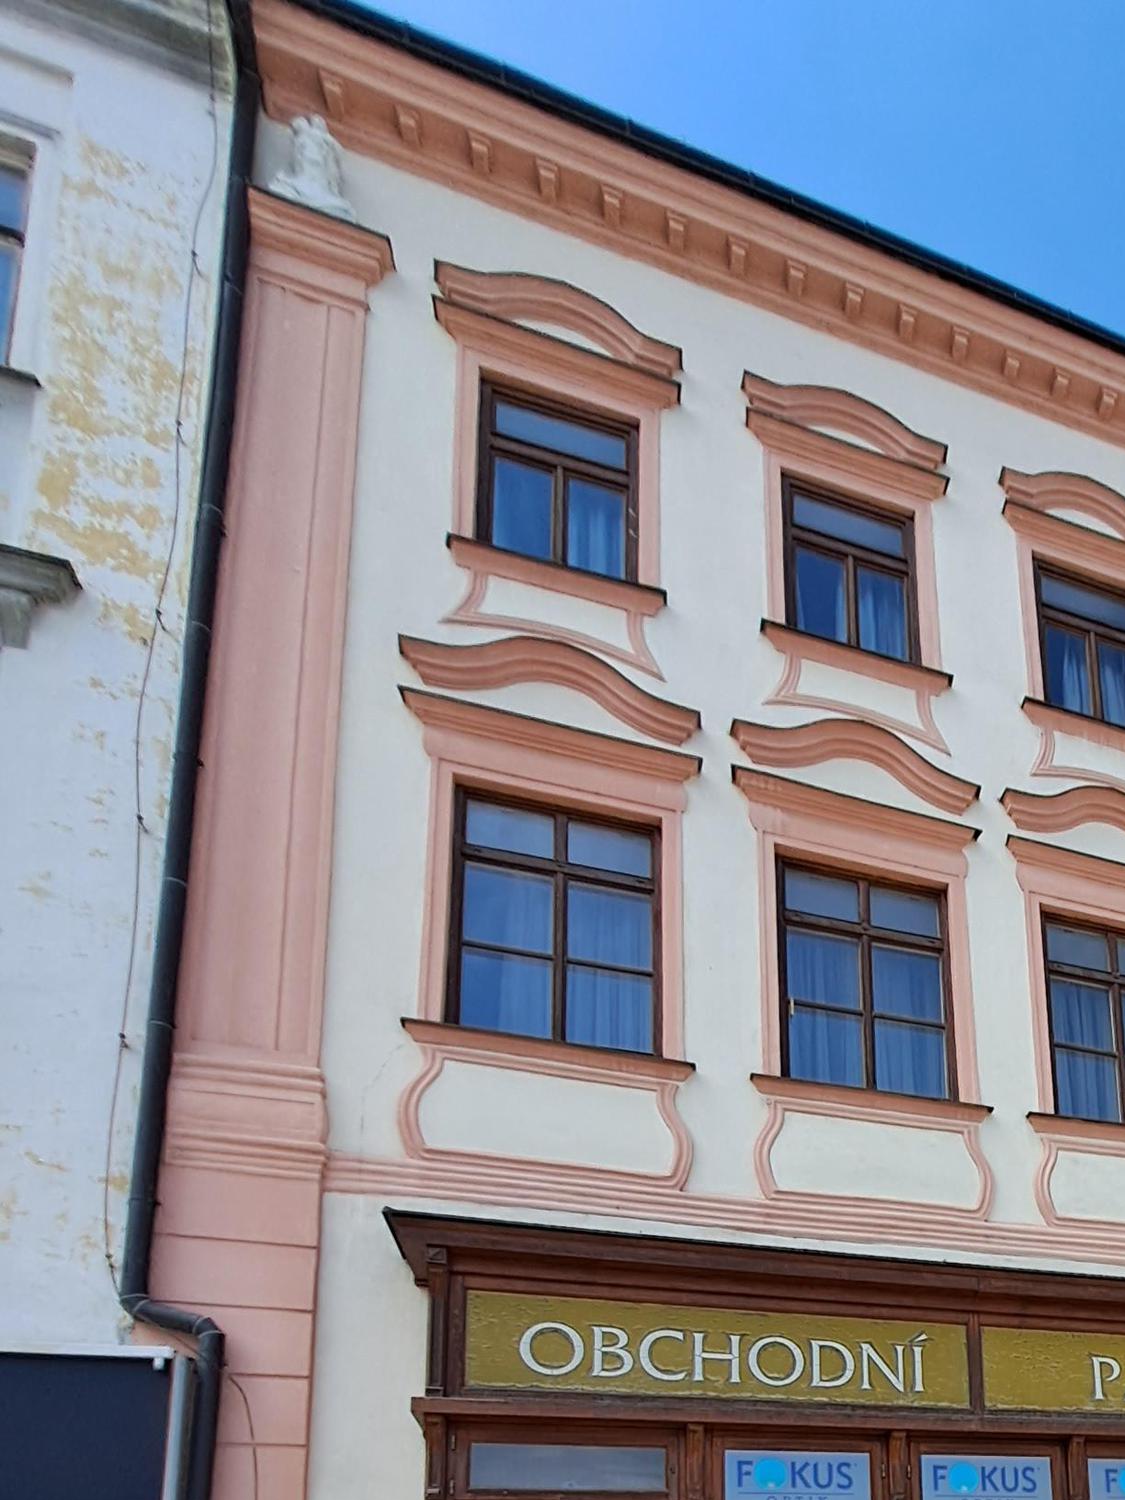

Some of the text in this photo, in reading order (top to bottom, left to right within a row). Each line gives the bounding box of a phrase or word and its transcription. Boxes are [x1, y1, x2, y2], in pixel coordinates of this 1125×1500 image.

[519, 1321, 929, 1394] OBCHODNÍ
[737, 1458, 854, 1490] FOKUS
[932, 1462, 1038, 1494] FOKUS
